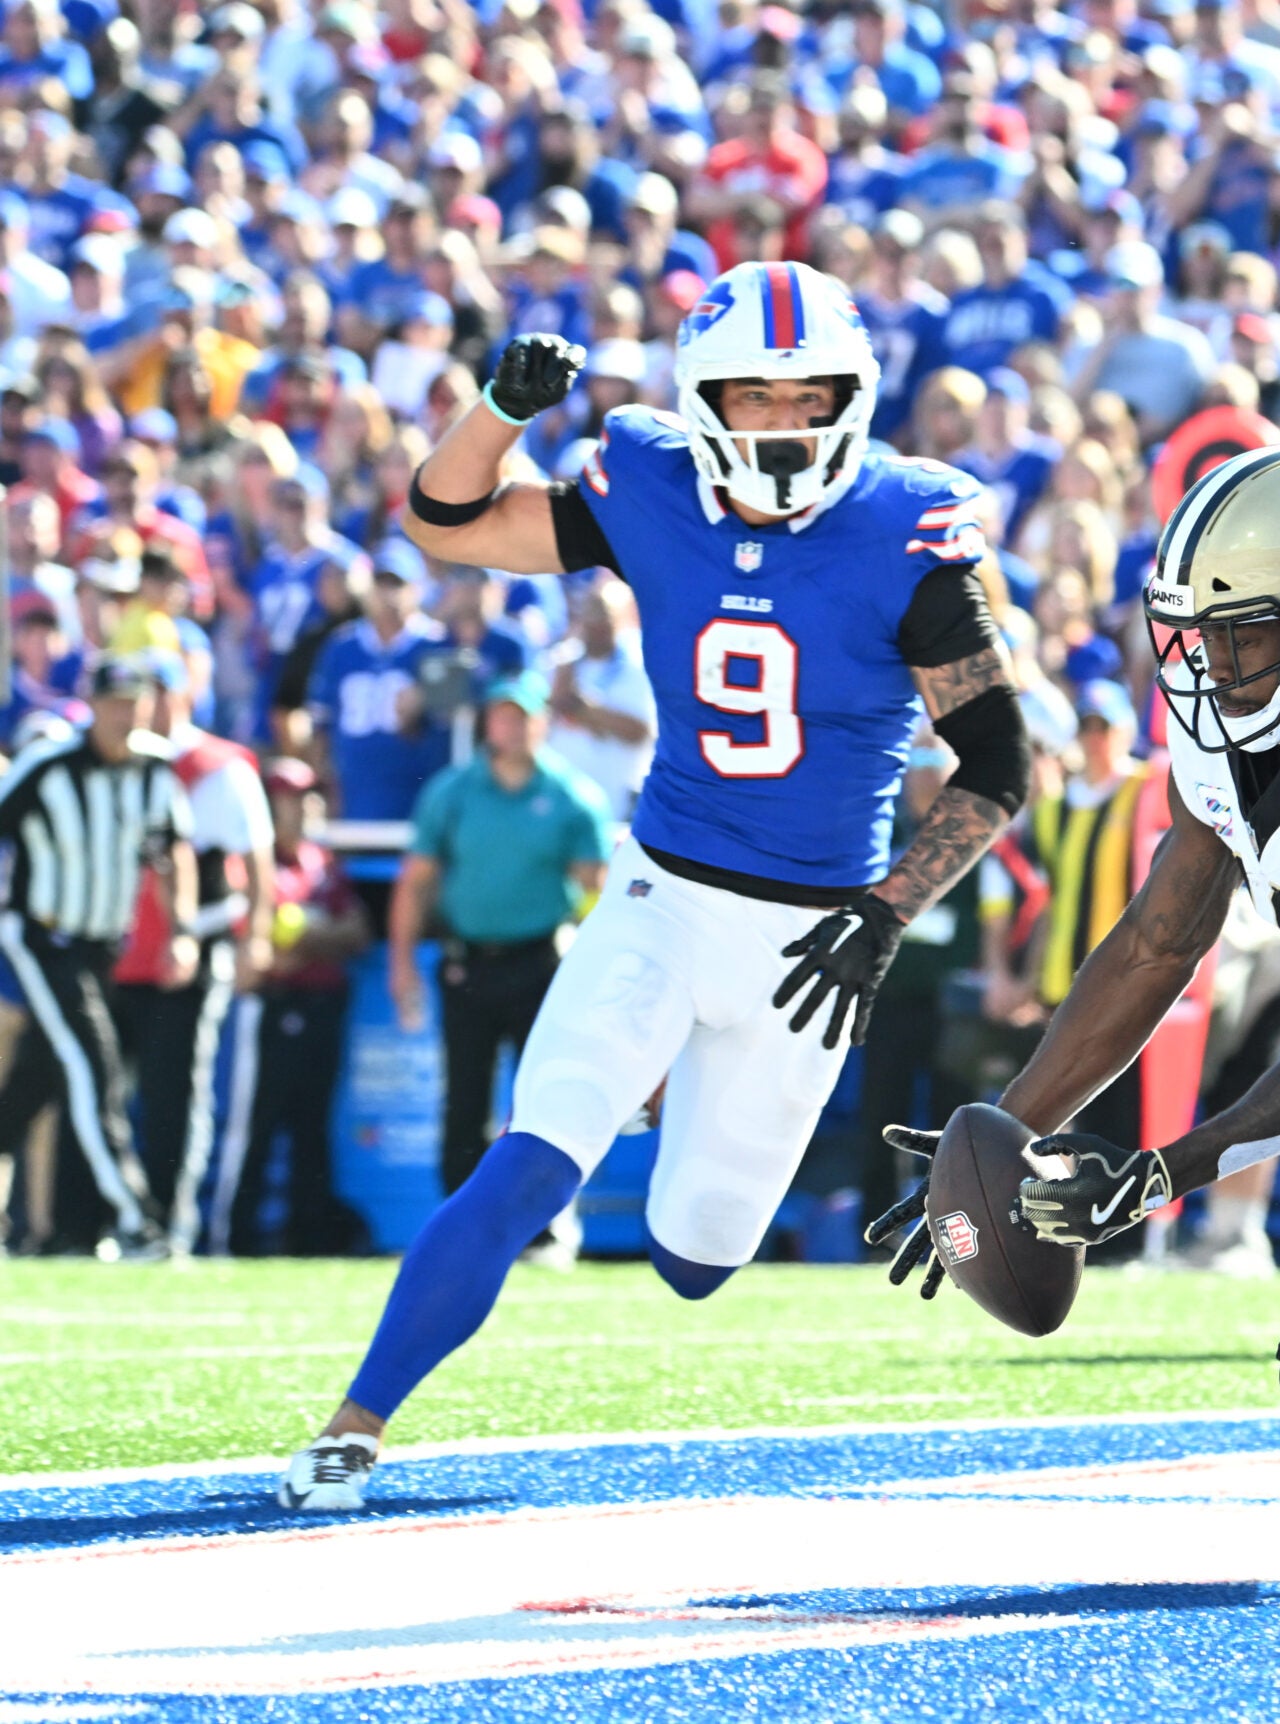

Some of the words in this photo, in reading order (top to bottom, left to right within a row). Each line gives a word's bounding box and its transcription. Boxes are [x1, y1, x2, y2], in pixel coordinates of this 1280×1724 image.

[720, 594, 774, 613] BILLS
[1150, 588, 1184, 606] SAINTS
[693, 615, 806, 779] 9
[946, 1215, 974, 1258] NFL
